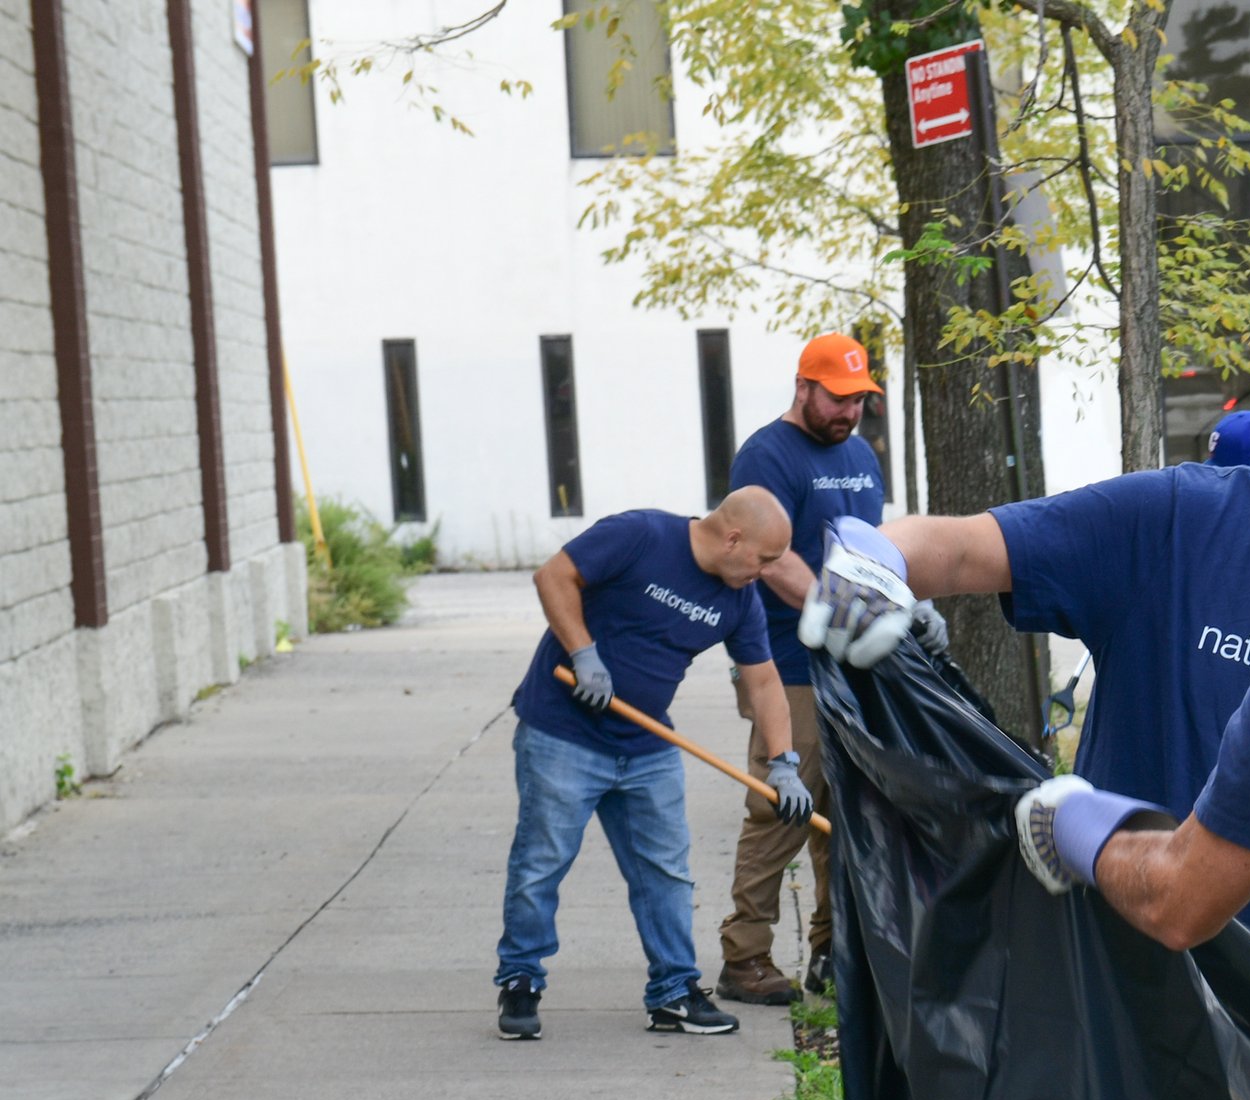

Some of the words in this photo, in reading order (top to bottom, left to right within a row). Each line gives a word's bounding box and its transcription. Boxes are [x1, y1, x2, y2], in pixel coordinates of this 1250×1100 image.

[911, 66, 925, 85] NO
[925, 55, 967, 80] STANDIN
[914, 82, 953, 104] Anytime
[644, 583, 722, 627] nationalgrid
